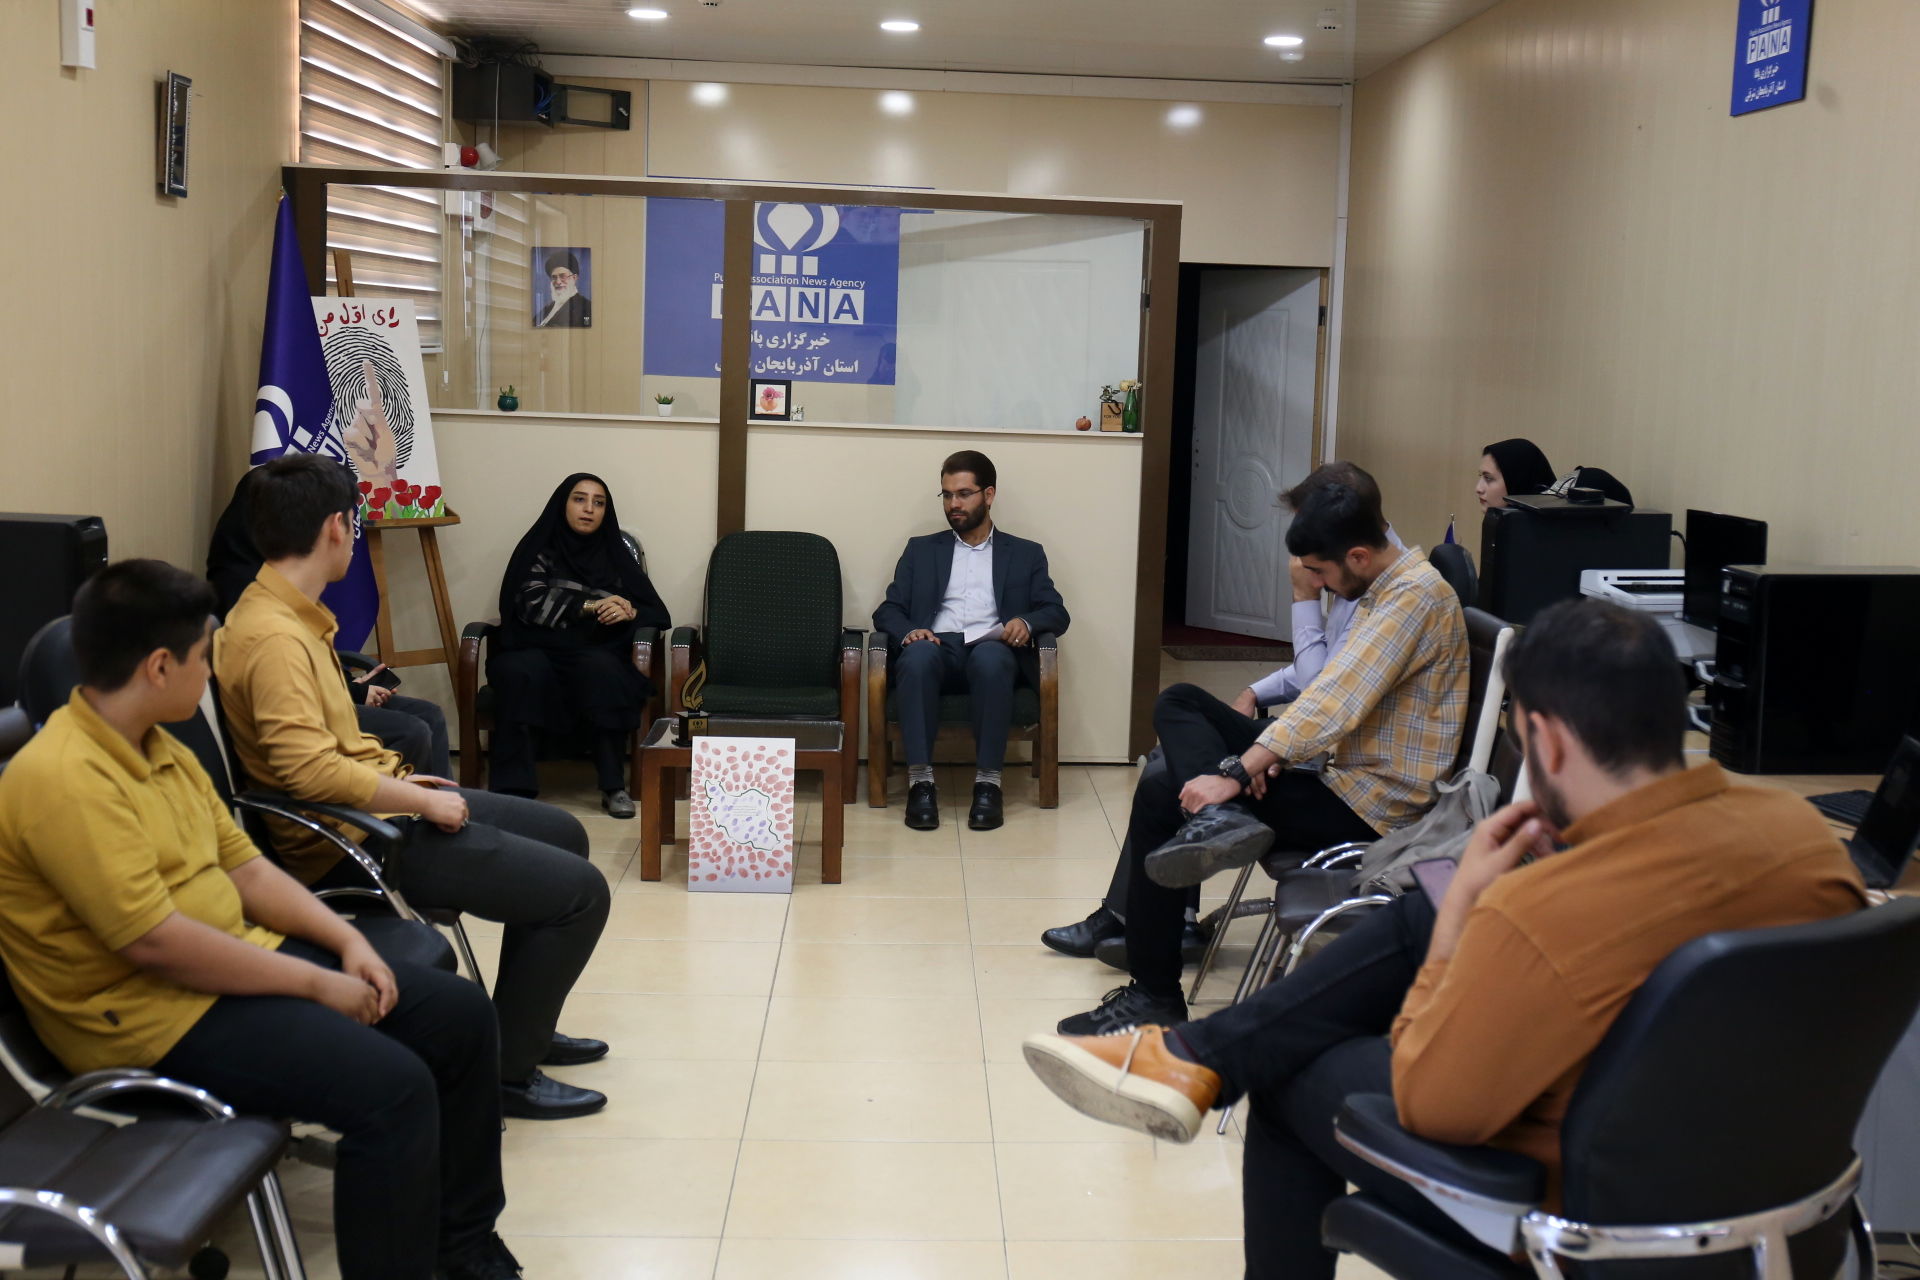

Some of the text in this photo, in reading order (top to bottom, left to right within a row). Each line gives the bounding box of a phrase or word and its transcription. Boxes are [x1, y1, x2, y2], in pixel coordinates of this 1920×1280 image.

[1748, 29, 1790, 60] PANA
[752, 275, 865, 289] ssociation News Agency
[721, 287, 859, 321] ANA
[318, 312, 334, 337] من
[766, 331, 831, 350] خبرگزاری
[754, 355, 821, 375] آذربایجان
[823, 358, 859, 376] استان
[307, 430, 325, 453] News
